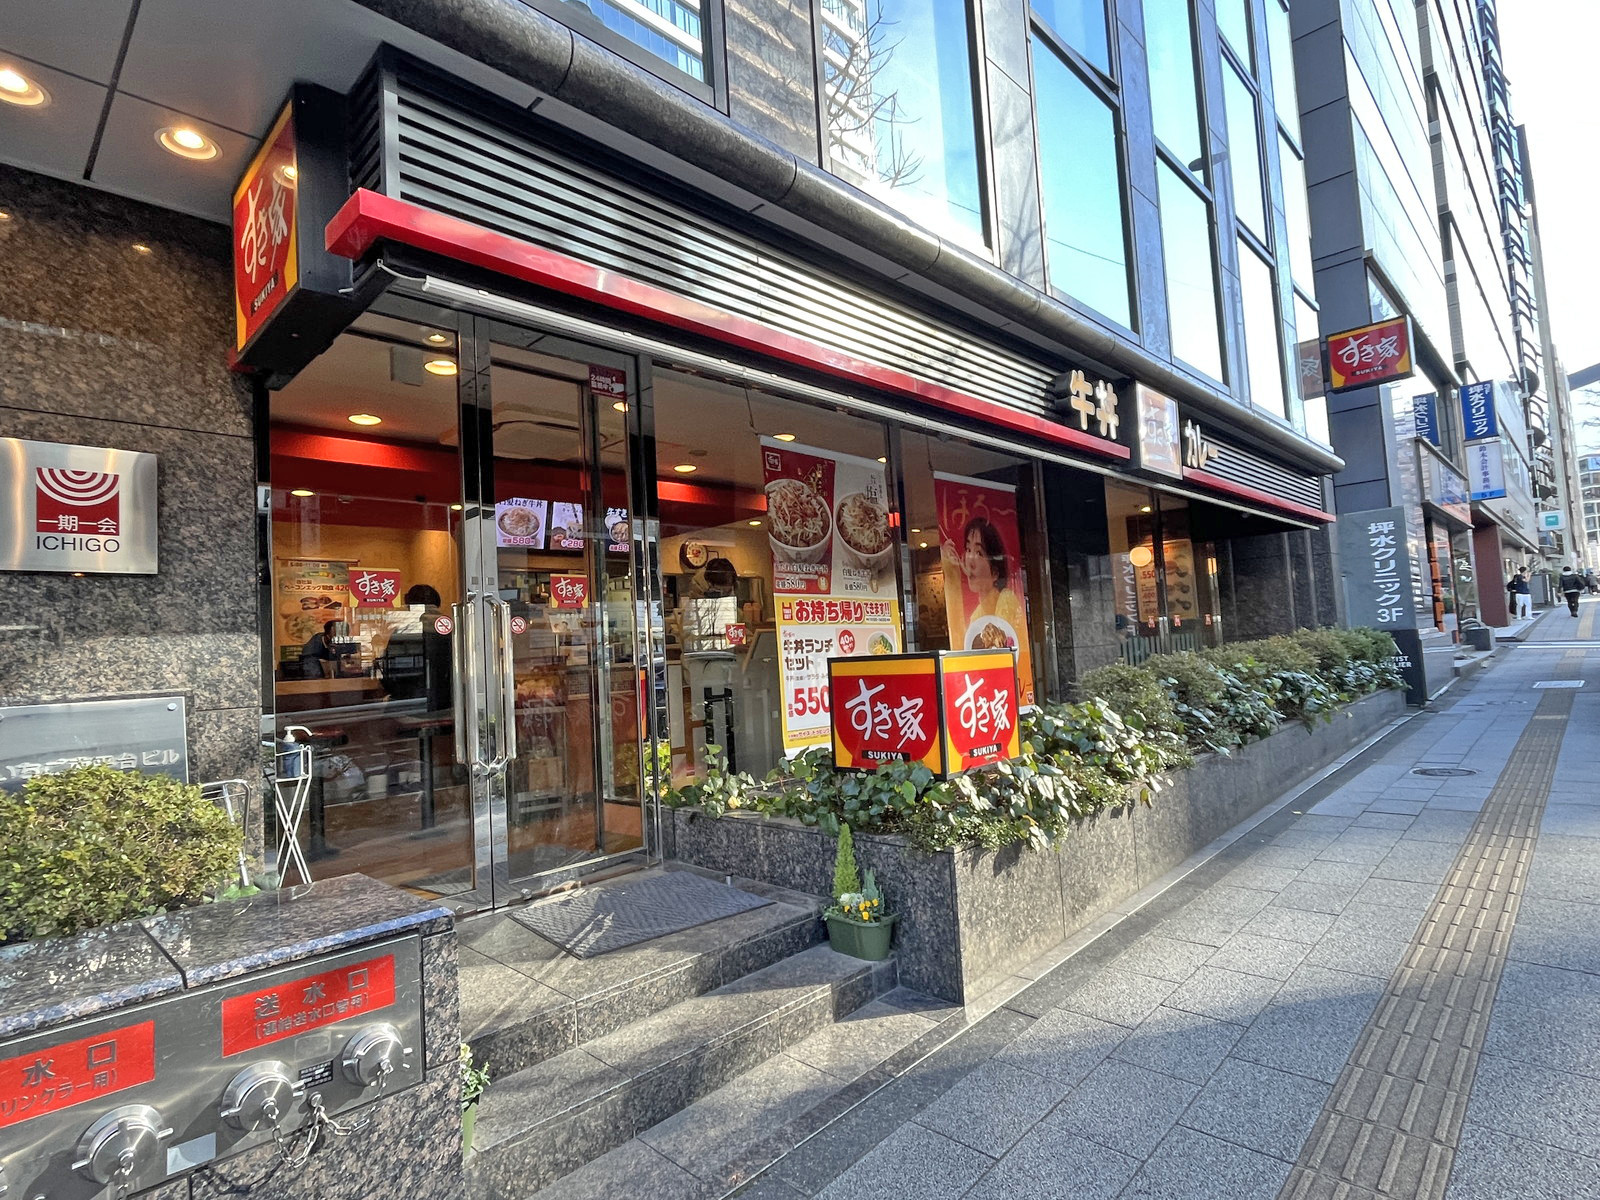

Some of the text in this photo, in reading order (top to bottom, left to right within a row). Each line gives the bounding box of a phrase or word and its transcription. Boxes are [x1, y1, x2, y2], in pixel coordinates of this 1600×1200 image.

[241, 178, 288, 283] すき家
[253, 276, 276, 311] SUKIYA
[1337, 334, 1400, 367] すき家
[1355, 366, 1383, 376] SUKIYA
[1070, 369, 1120, 440] 牛丼
[1467, 384, 1489, 436] 坪水クリニック
[39, 514, 117, 534] 一期一会
[36, 535, 120, 553] ICHIGO
[1368, 521, 1401, 607] 坪水クリニック
[355, 571, 396, 598] すき家
[555, 578, 585, 600] すき家
[1376, 607, 1403, 623] 3F
[783, 638, 834, 655] 牛丼ランチ
[785, 655, 815, 672] セット
[845, 678, 927, 750] すき家
[954, 673, 1011, 741] すき家
[867, 750, 903, 760] SUKIYA
[972, 744, 998, 757] SUKIYA
